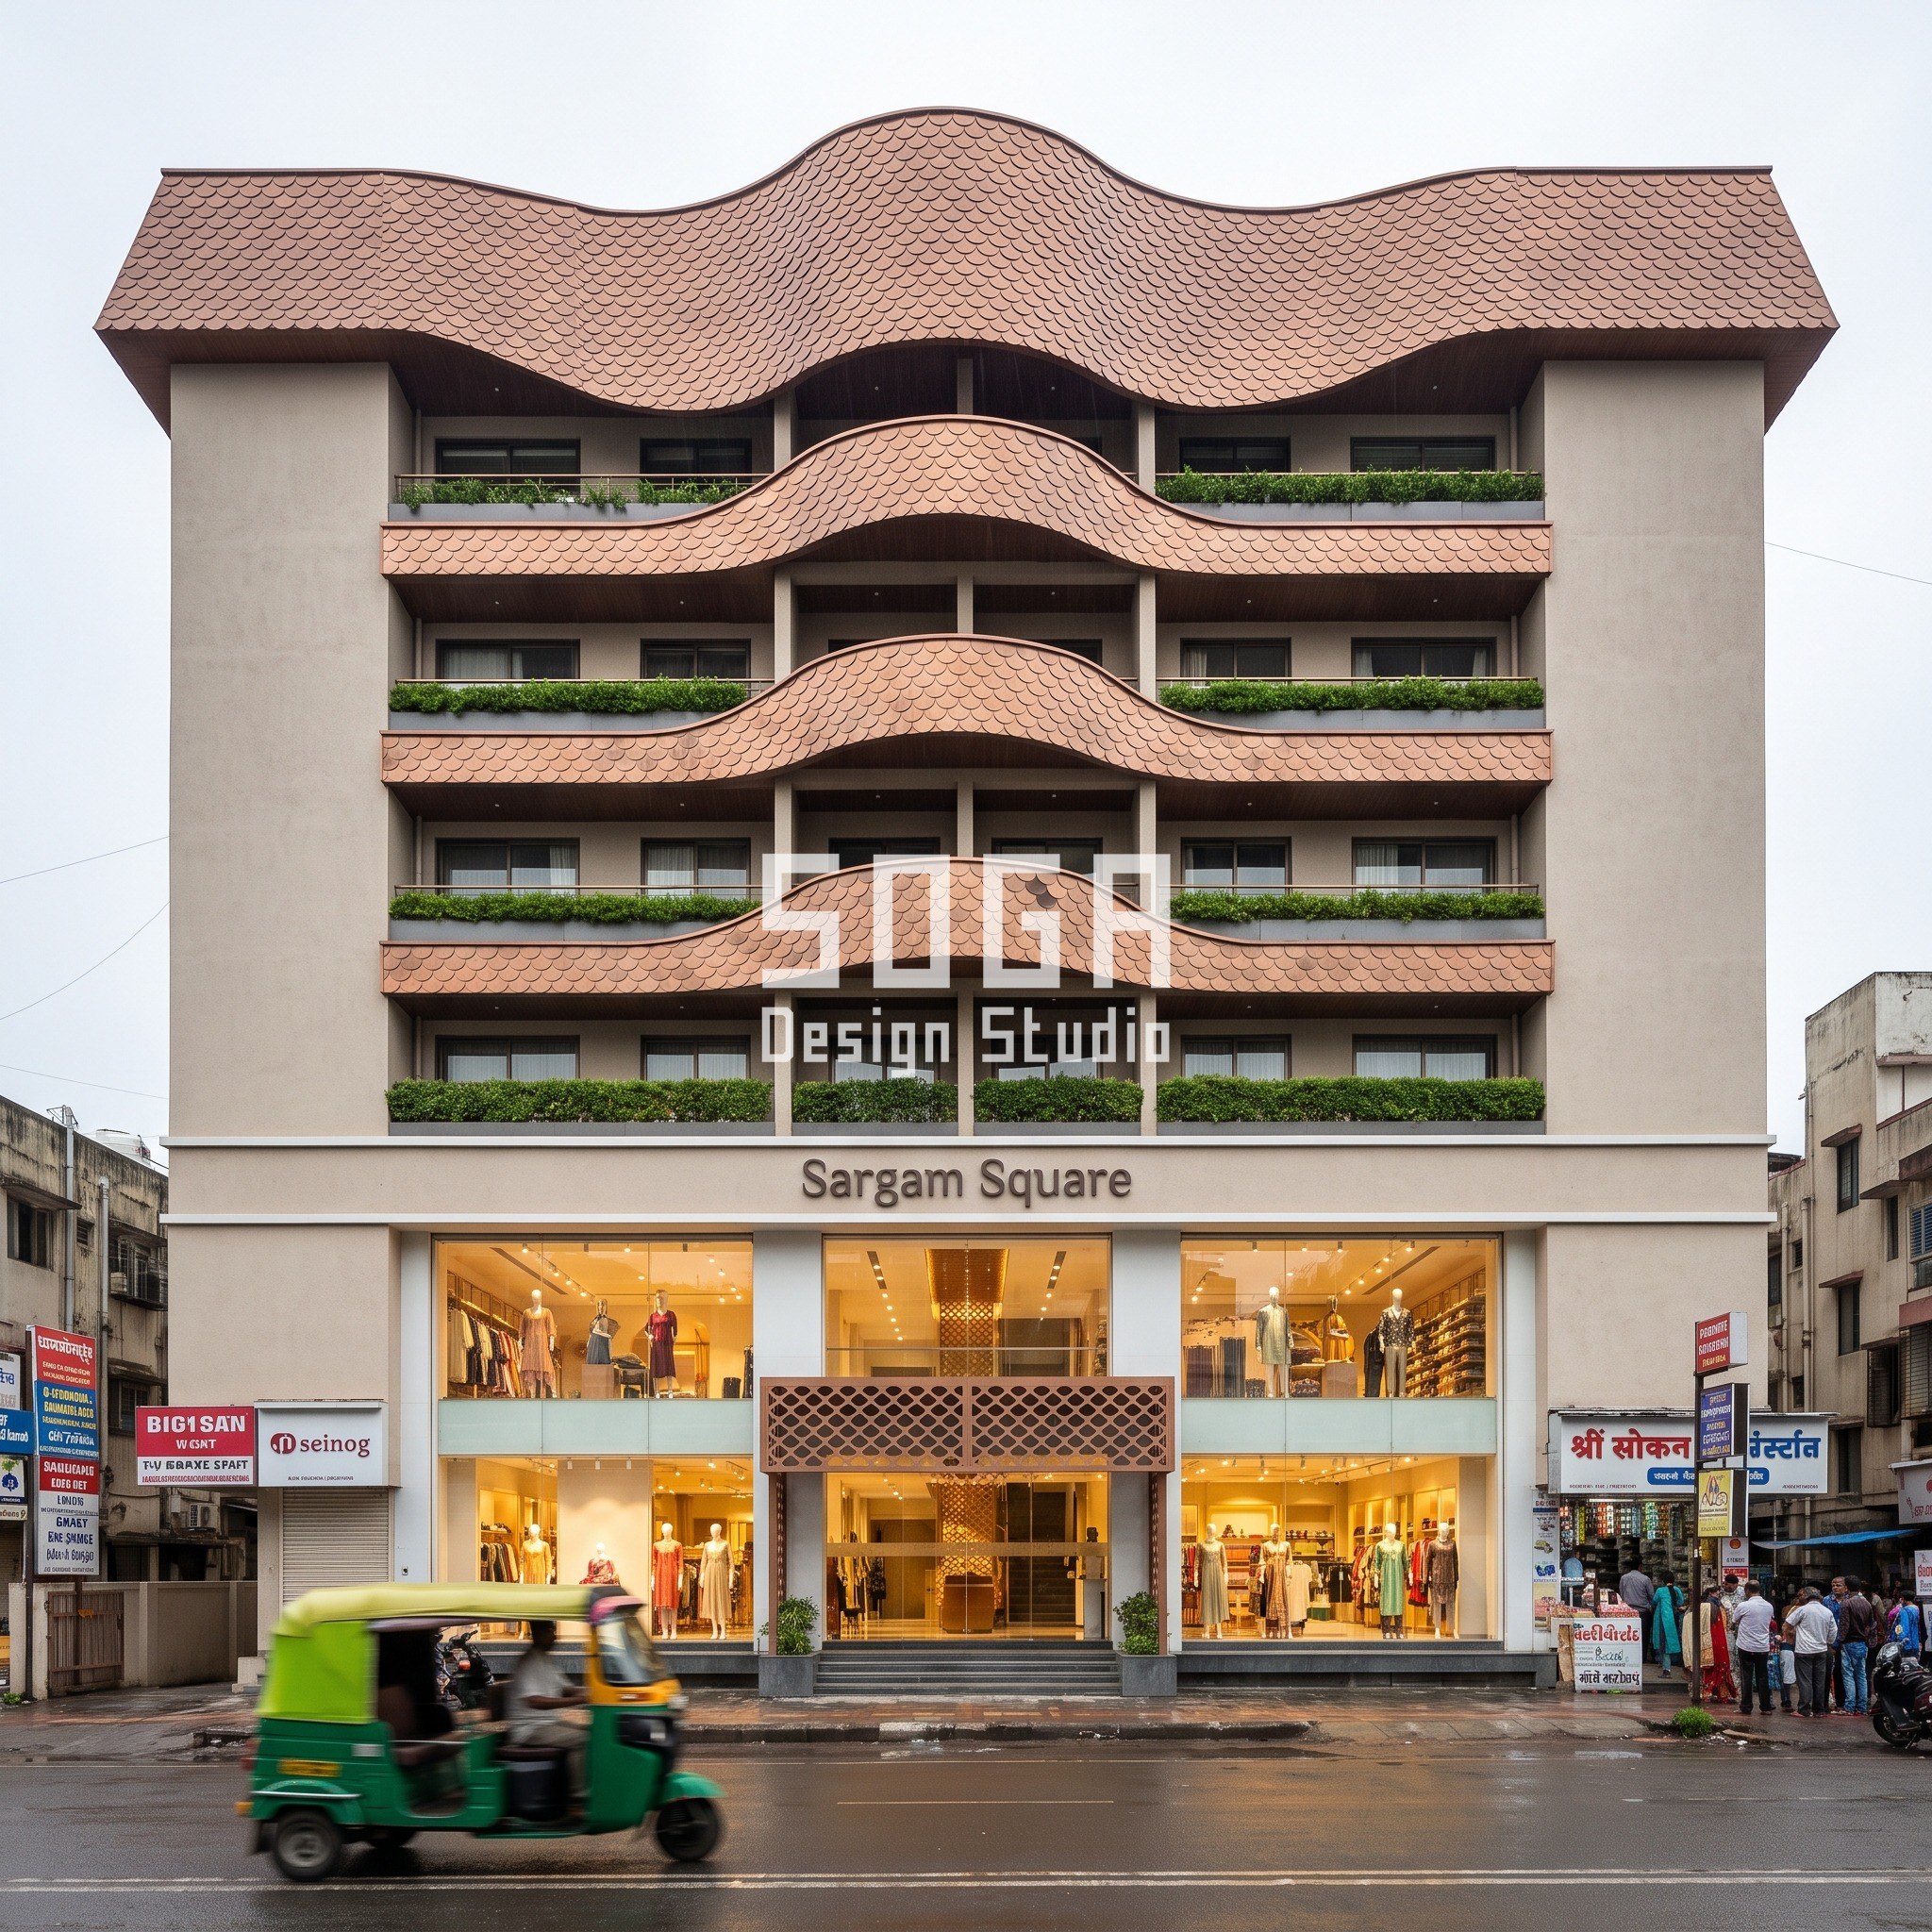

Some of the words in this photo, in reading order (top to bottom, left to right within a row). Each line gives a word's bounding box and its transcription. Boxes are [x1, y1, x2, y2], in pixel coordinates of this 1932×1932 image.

[802, 1158, 963, 1208] Sargam
[980, 1158, 1132, 1208] Square
[300, 1433, 371, 1458] seinog
